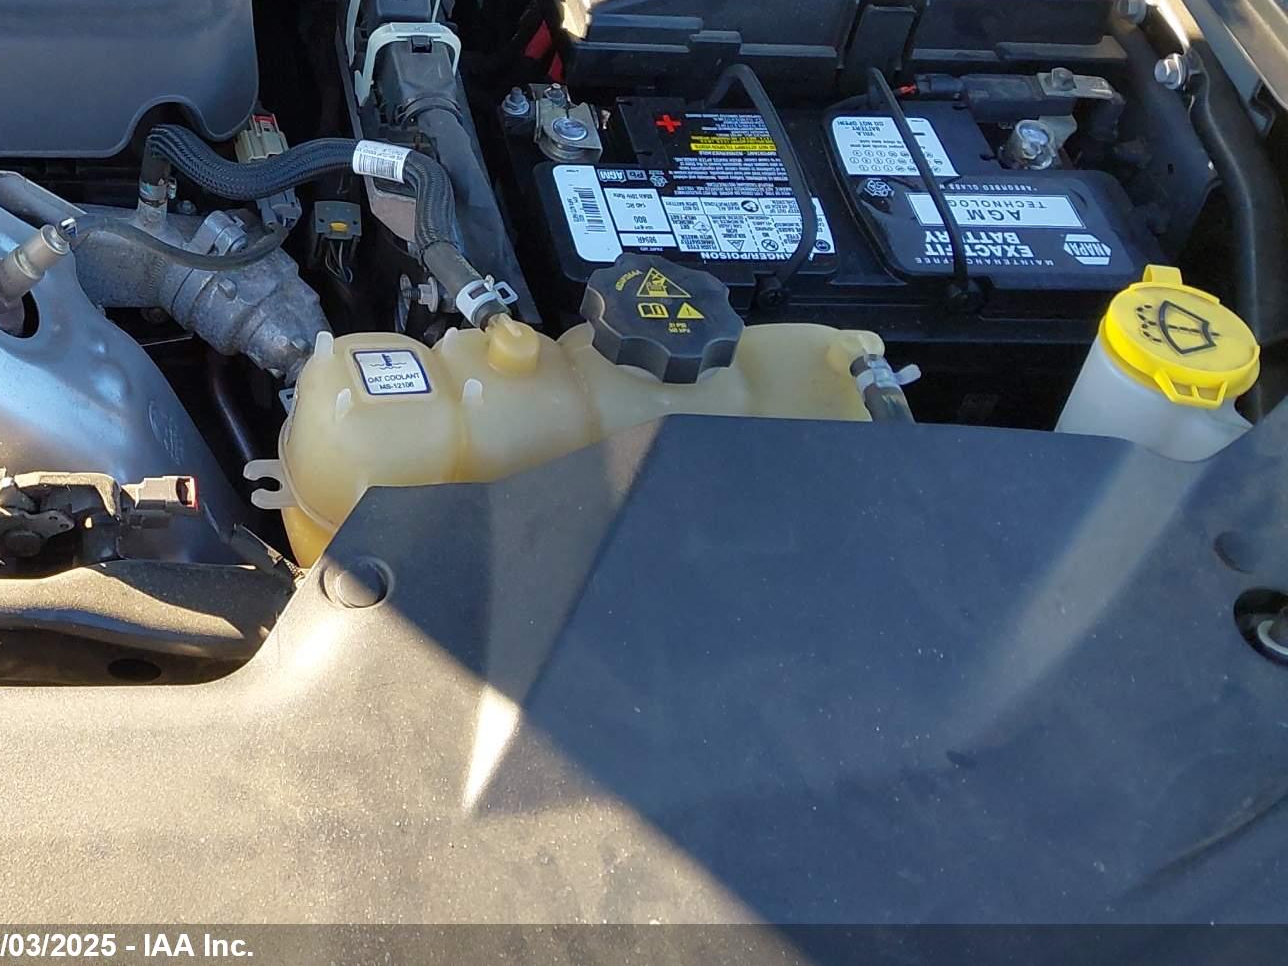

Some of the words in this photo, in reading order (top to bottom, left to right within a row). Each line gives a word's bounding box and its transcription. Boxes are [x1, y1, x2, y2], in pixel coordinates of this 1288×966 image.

[599, 170, 622, 179] AGM
[945, 199, 1047, 209] TECHNOLOG
[925, 231, 1021, 244] BATTRY
[925, 244, 954, 256] FIT
[964, 244, 1035, 257] EXACT
[1070, 242, 1106, 255] NAPA
[700, 251, 792, 260] ANGER/POISON
[914, 257, 1054, 266] MAINTENANC-FREE
[367, 375, 382, 384] OAT
[384, 372, 420, 382] COOLANT
